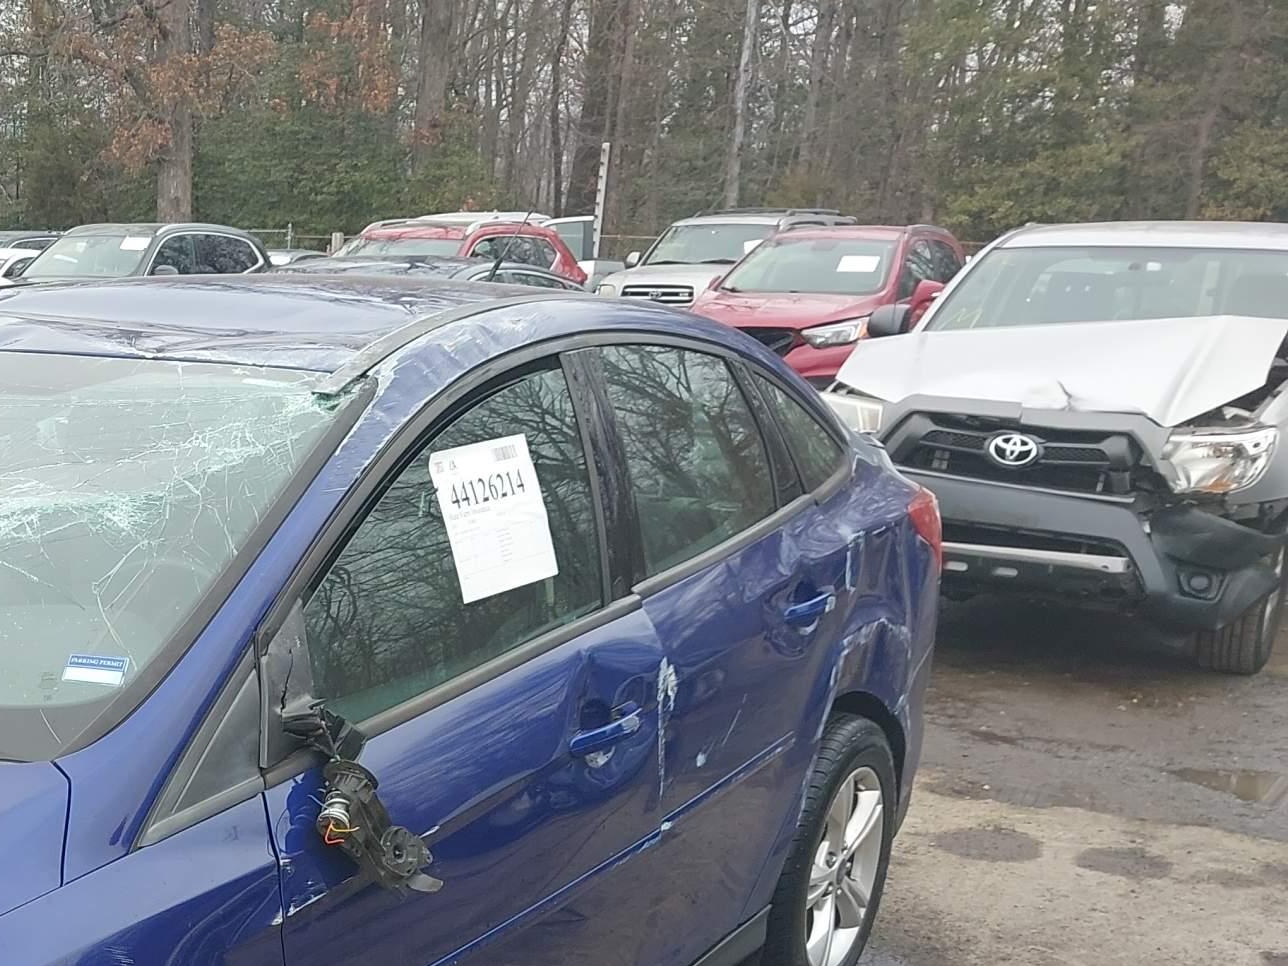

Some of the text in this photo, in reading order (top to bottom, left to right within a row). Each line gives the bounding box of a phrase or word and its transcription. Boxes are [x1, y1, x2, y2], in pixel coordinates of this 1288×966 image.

[451, 468, 525, 509] 44126214
[72, 656, 123, 668] PARKING PERMIT
